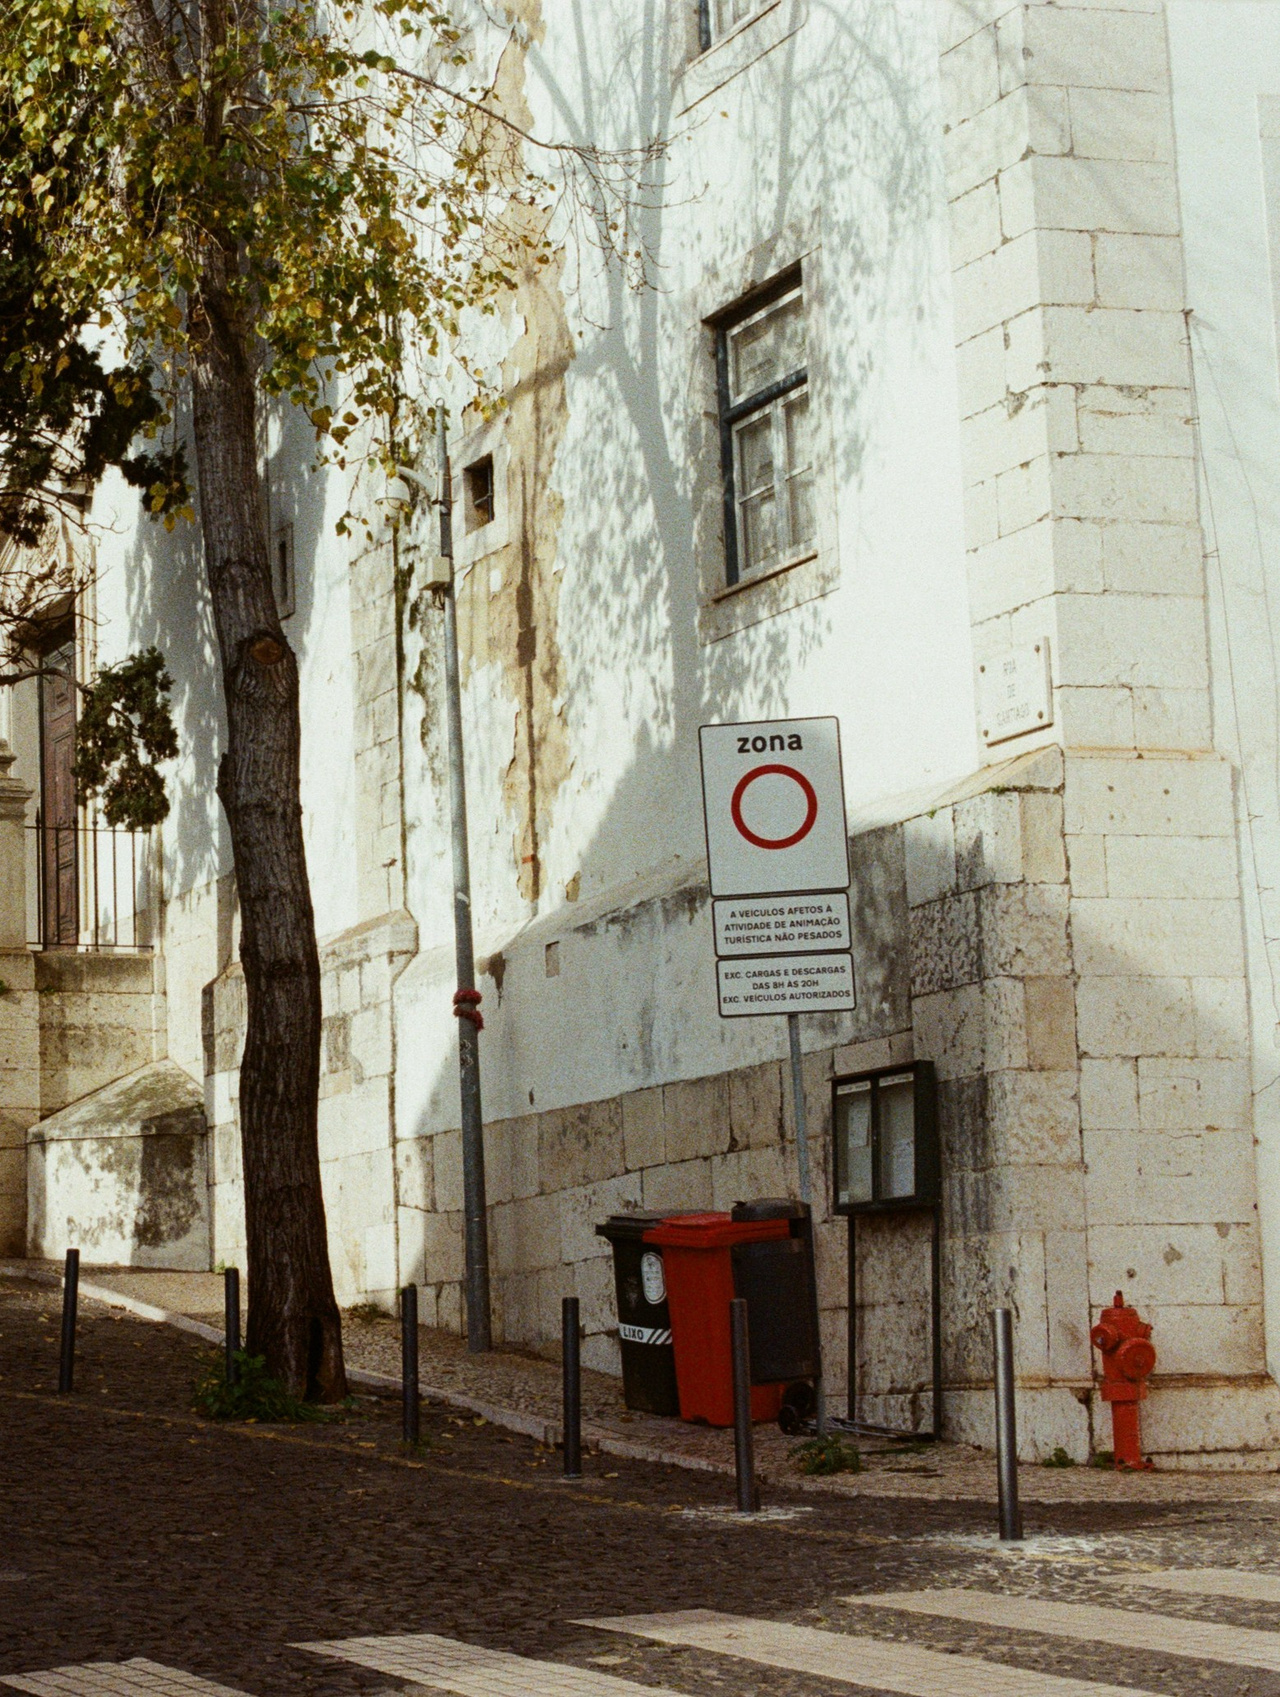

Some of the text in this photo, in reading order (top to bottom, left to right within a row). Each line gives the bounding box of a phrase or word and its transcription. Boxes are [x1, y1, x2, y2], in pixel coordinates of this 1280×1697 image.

[736, 733, 803, 754] zona
[730, 911, 737, 919] A
[738, 907, 785, 918] VEÍCULOS
[787, 905, 824, 915] AFETOS
[724, 917, 841, 932] ATIVIDADE DE ANIMAÇÃO
[724, 930, 842, 944] TURÍSTICA NÃO PESADOS
[724, 966, 846, 979] EXC. CARGAS E DESCARGAS
[752, 981, 770, 990] DAS
[772, 981, 785, 989] 8H
[801, 980, 819, 988] 20H
[722, 990, 851, 1004] EXC. VEÍCULOS AUTORIZADOS
[623, 1326, 644, 1341] LIXO
